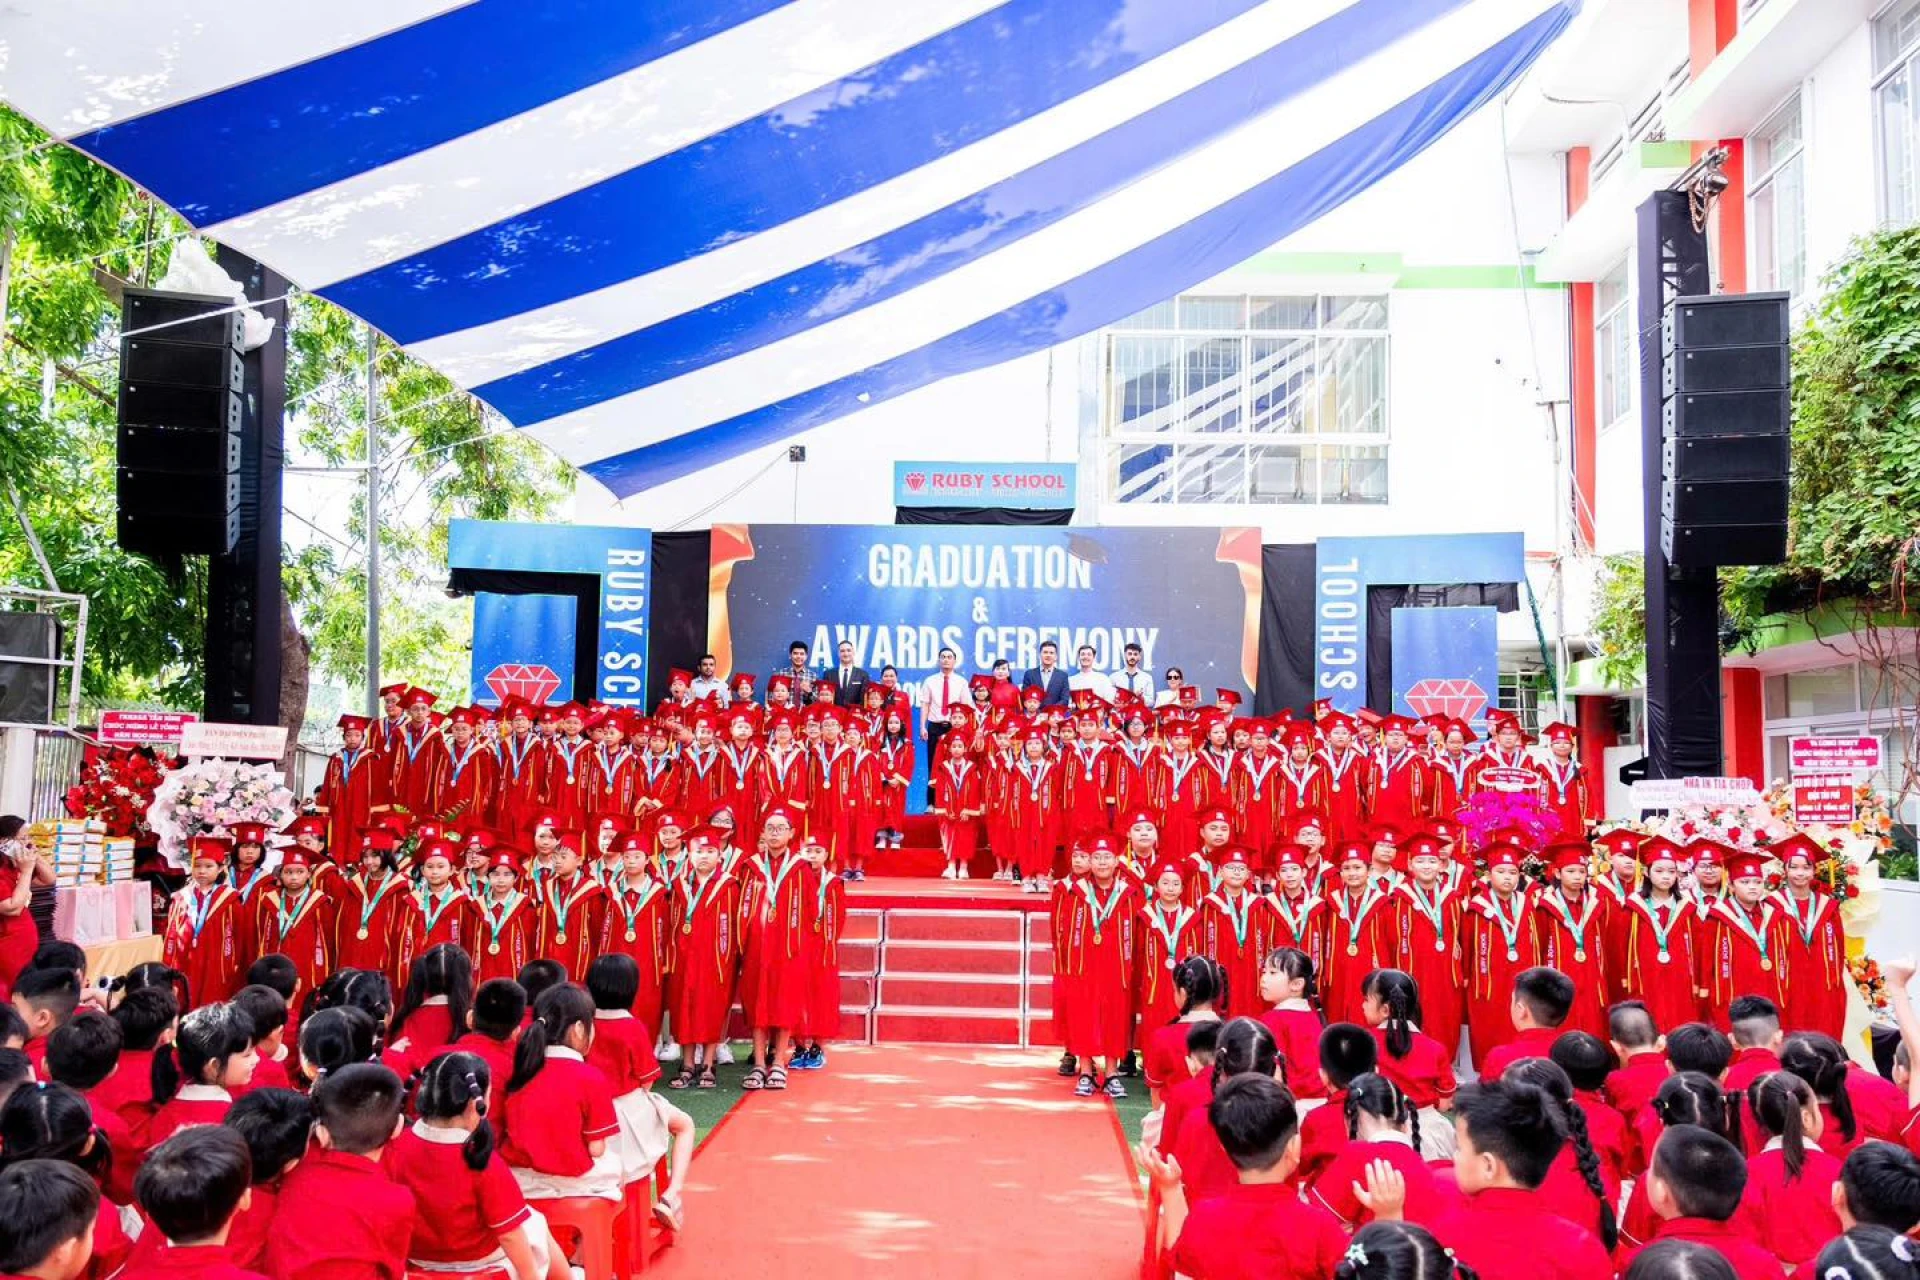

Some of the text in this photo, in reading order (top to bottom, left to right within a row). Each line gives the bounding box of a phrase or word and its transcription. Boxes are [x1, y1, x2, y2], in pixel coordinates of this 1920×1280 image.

[932, 473, 1066, 490] RUBY SCHOOL
[868, 543, 1092, 589] GRADUATION
[605, 548, 645, 636] RUBY
[972, 596, 990, 624] &
[1320, 557, 1358, 690] SCHOOL
[808, 624, 1160, 670] AWARDS CEREMONY
